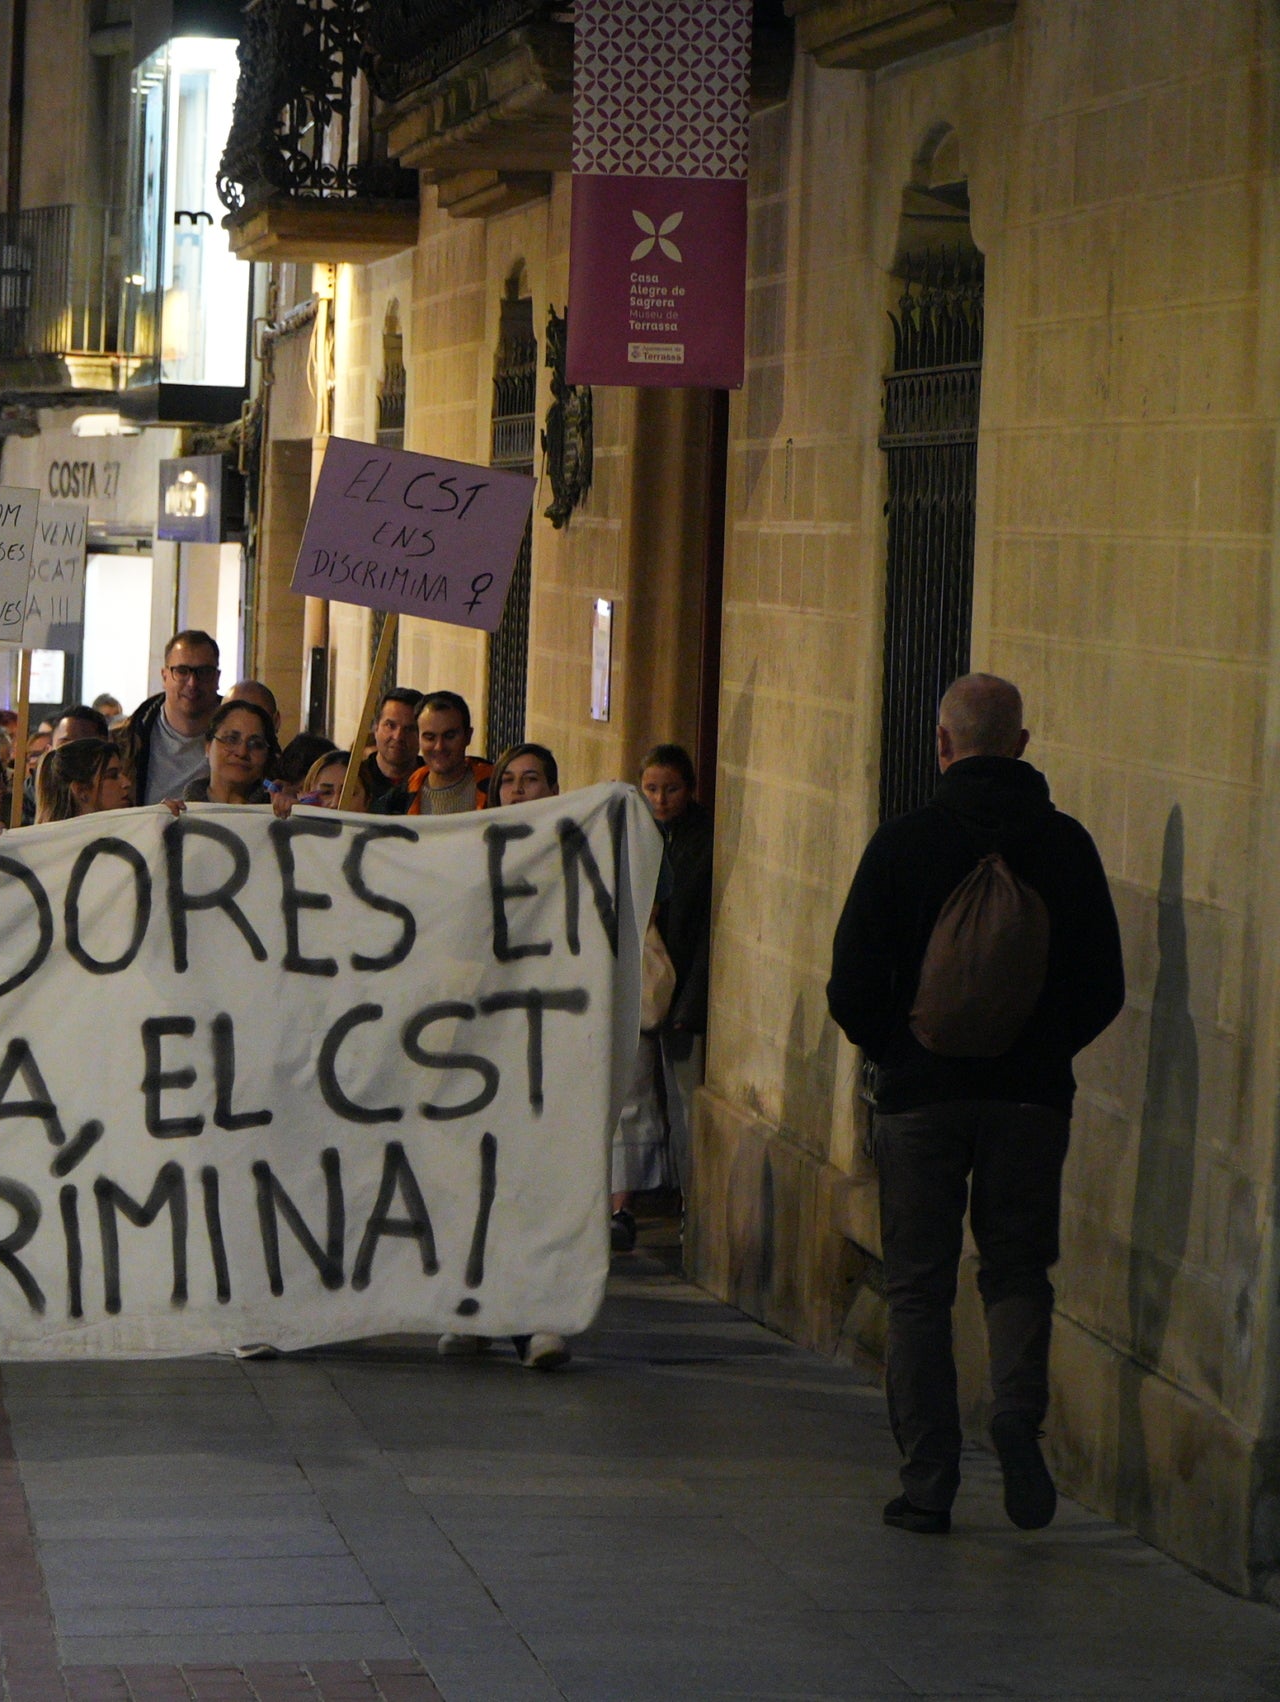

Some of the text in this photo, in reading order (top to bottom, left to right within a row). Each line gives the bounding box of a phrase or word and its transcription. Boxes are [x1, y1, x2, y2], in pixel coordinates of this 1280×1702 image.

[630, 272, 659, 284] Casa
[629, 284, 686, 298] Alegre de
[629, 296, 675, 310] Sagrera
[629, 309, 679, 320] Museu de
[628, 320, 678, 332] Terrassa
[642, 352, 682, 361] Terrassa
[48, 461, 98, 498] COSTA
[344, 459, 489, 520] EL CST
[372, 521, 436, 557] ENS
[483, 797, 627, 962] EN
[141, 1011, 273, 1140] EL
[317, 986, 590, 1124] CST
